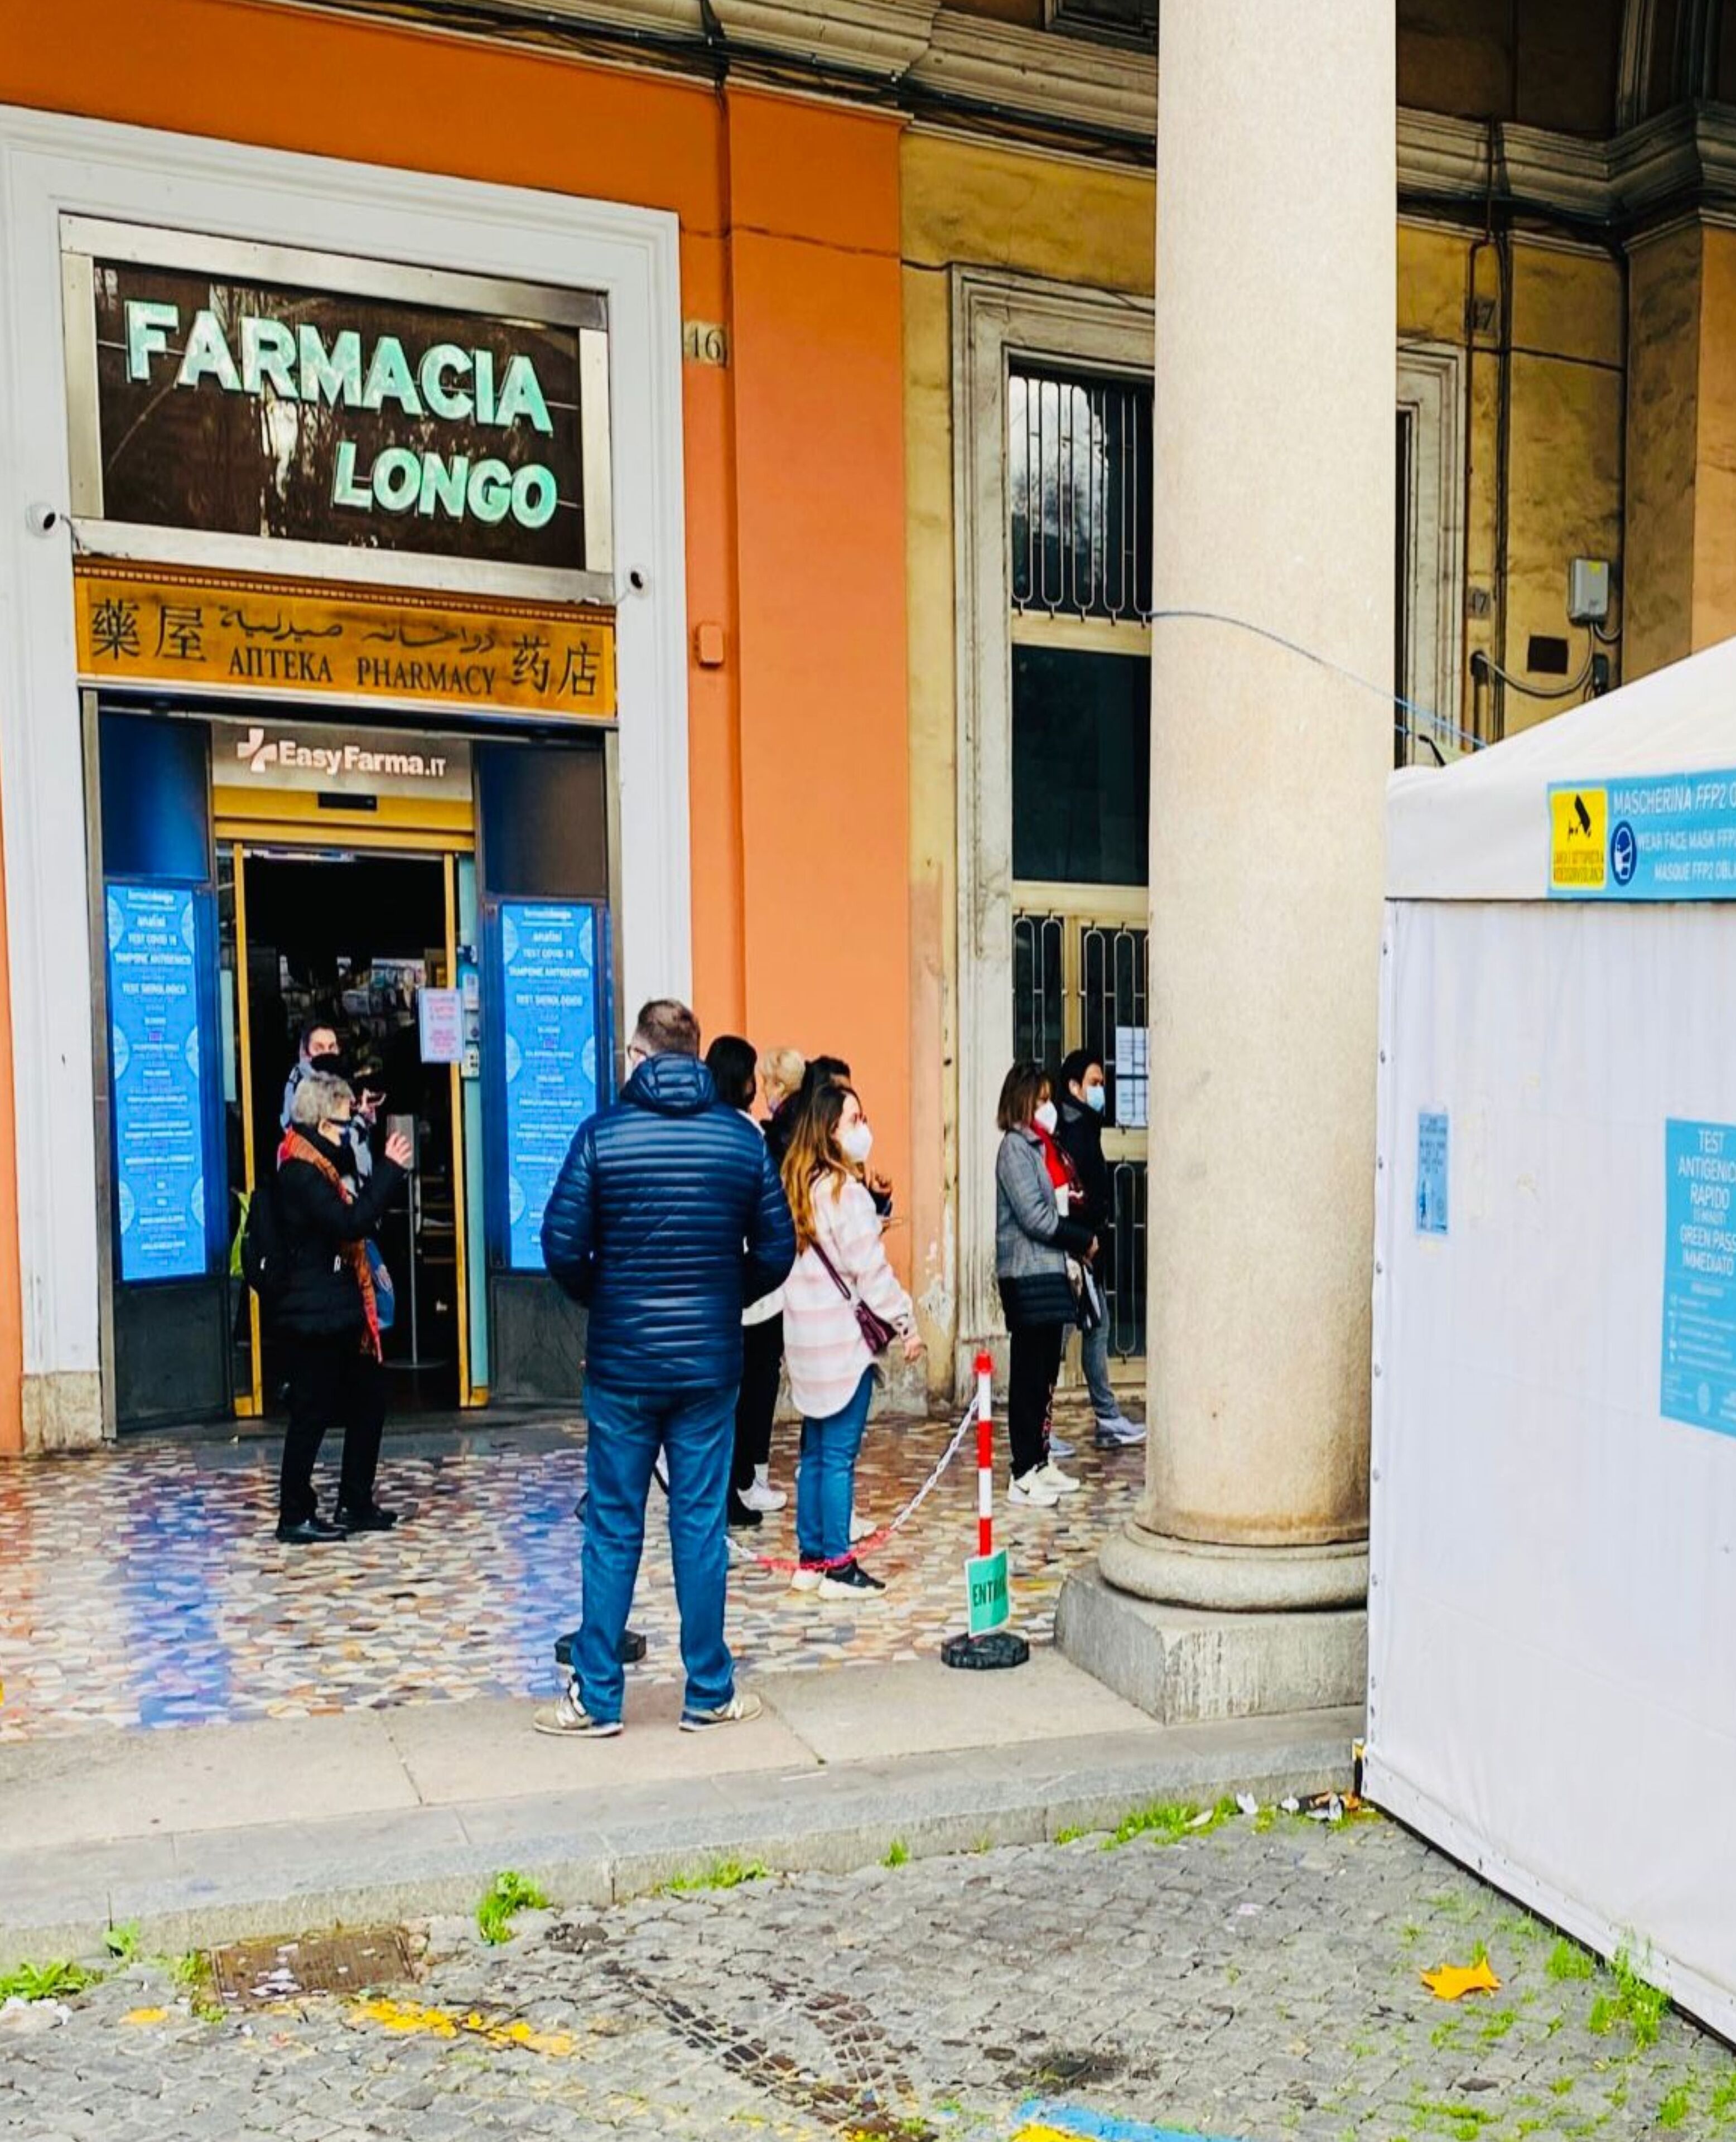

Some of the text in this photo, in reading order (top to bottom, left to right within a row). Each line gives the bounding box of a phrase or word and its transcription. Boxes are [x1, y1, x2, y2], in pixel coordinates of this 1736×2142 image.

[689, 326, 720, 361] 16
[125, 300, 553, 437] FARMACIA
[332, 441, 557, 529] LONGO
[92, 597, 207, 662] 藥屋
[356, 656, 496, 696] PHARMACY
[511, 634, 601, 697] 药店
[1613, 784, 1691, 815] MASCHERINA
[1696, 783, 1727, 810] FFP2
[1638, 833, 1663, 851] WEAR
[1665, 831, 1687, 851] FACE
[1698, 1129, 1724, 1154] TEST
[1690, 1183, 1730, 1210] RAPIDO
[1680, 1224, 1710, 1247] GREEN
[1682, 1249, 1734, 1276] IMMEDIATO
